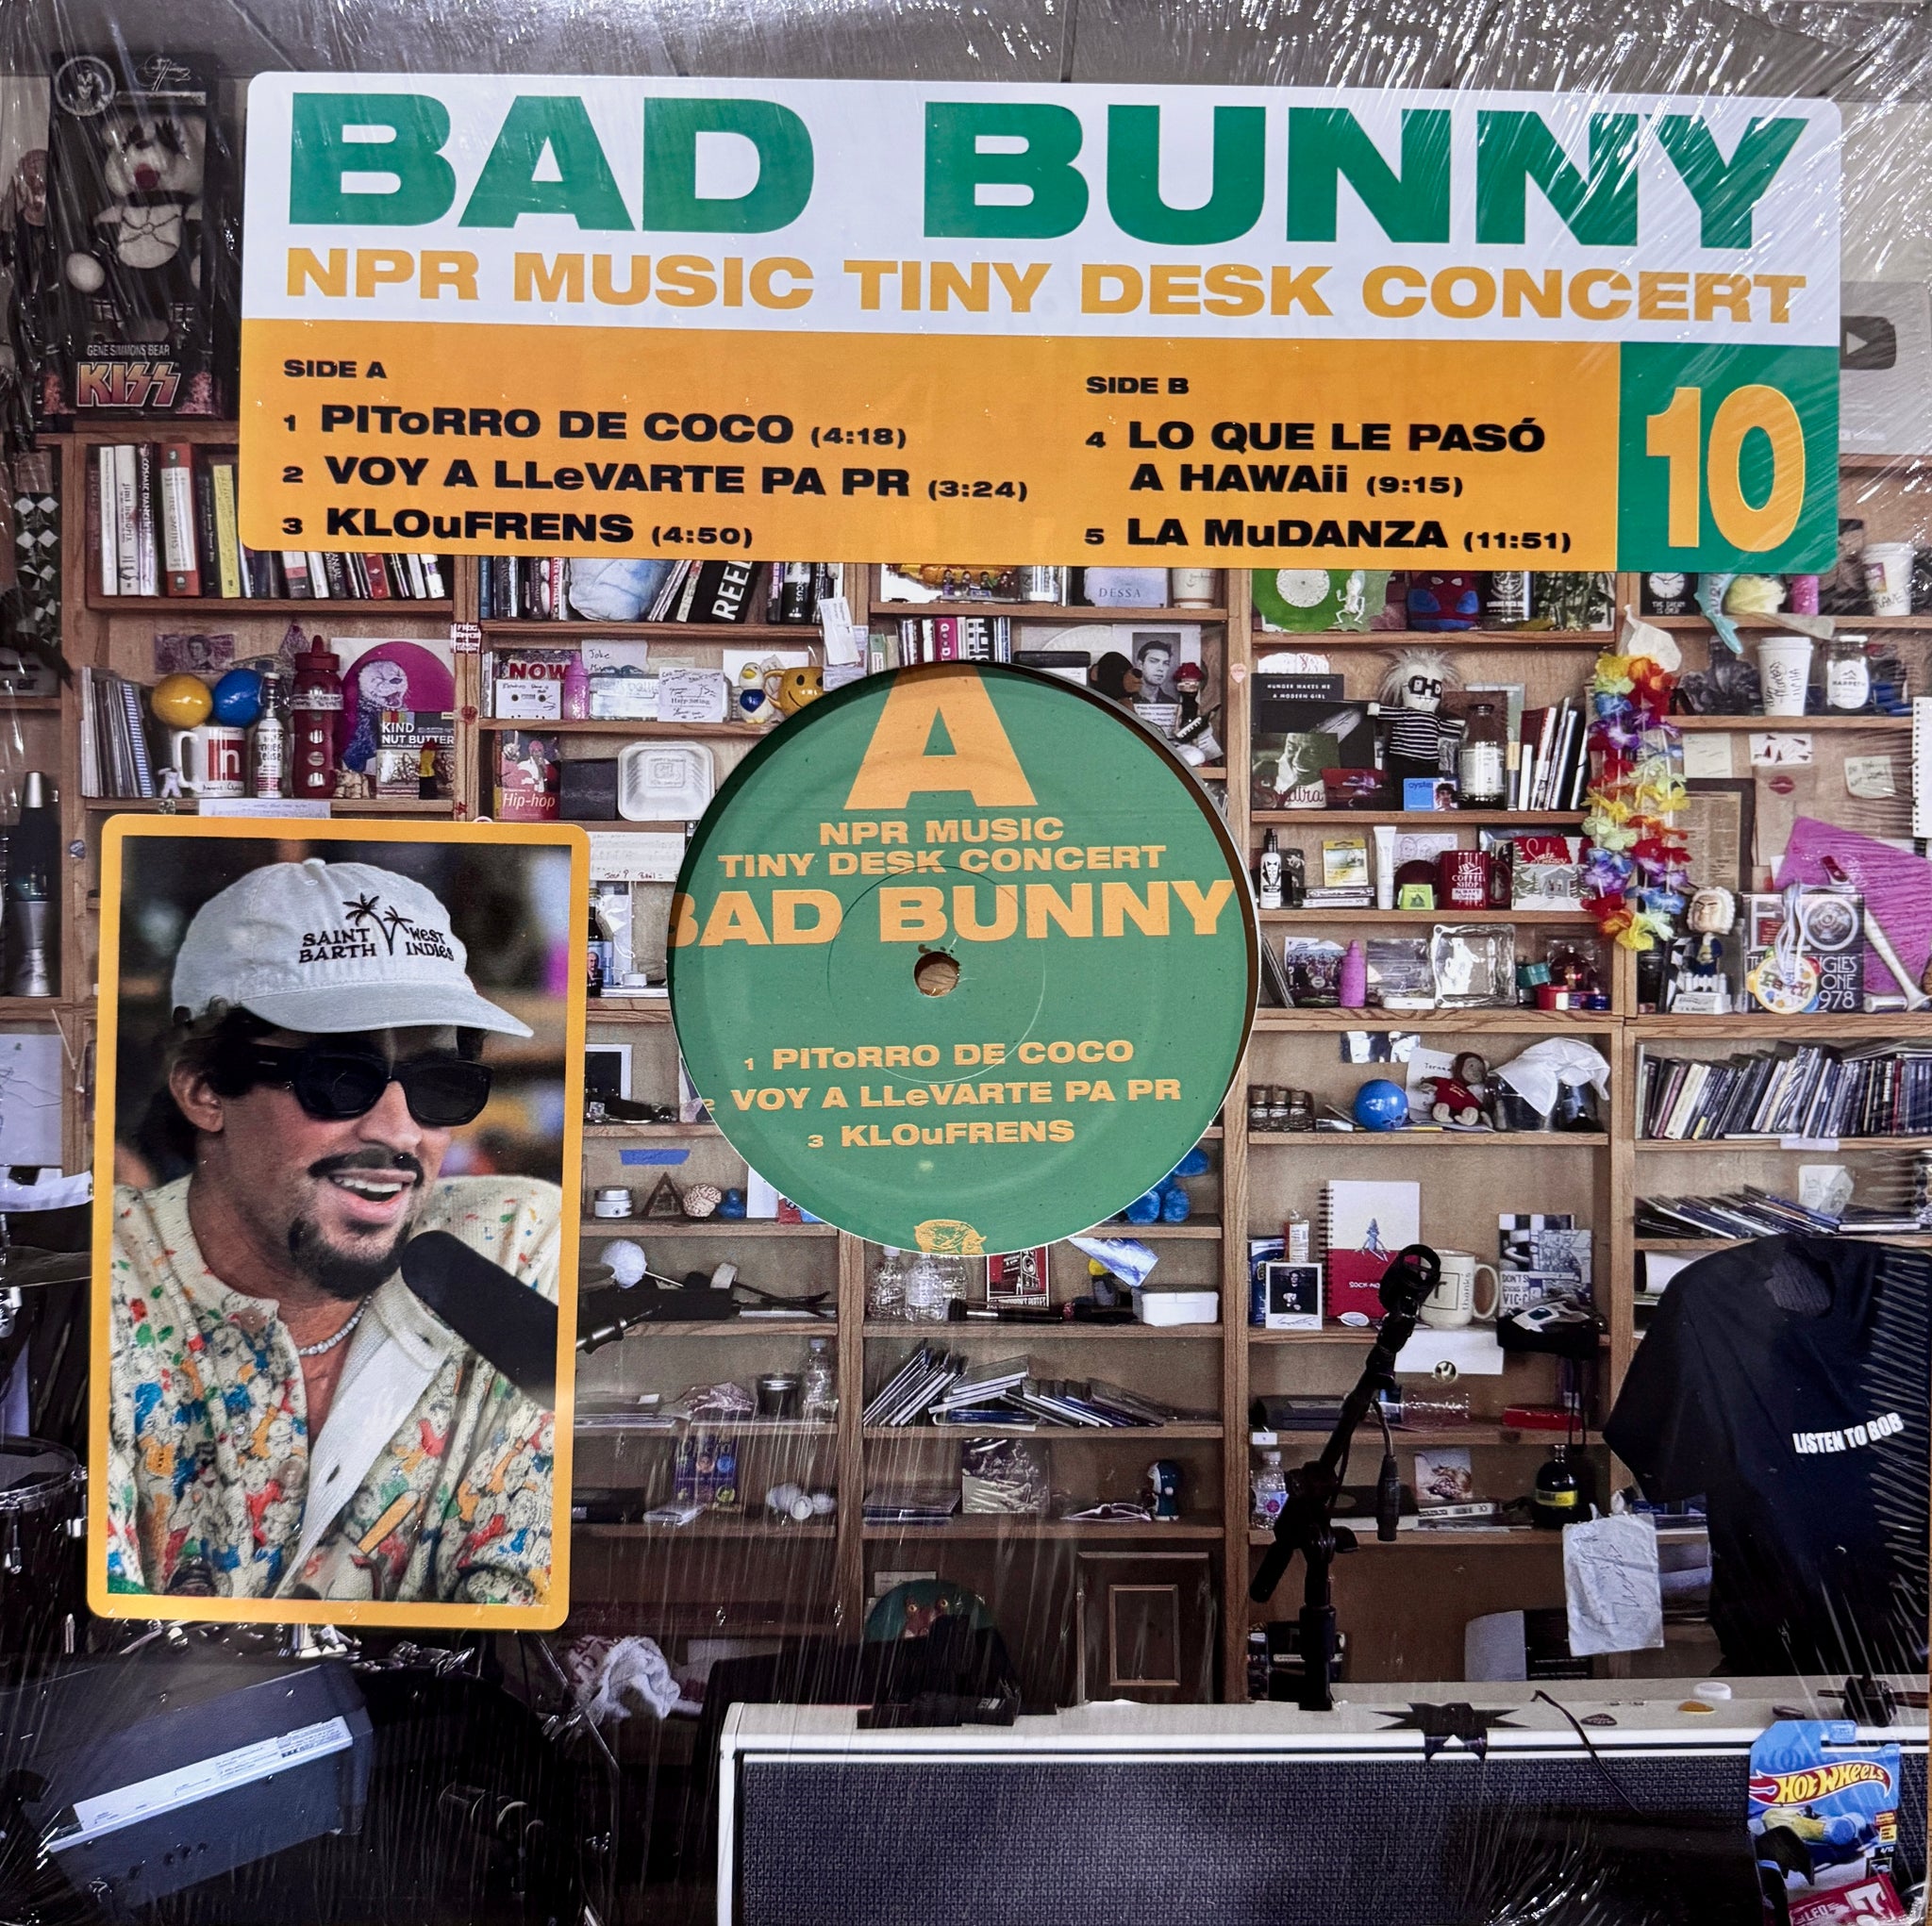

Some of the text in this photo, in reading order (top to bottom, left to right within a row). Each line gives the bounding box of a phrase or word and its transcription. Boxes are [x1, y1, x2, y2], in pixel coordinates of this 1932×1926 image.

[289, 91, 1809, 250] BAD BUNNY
[287, 247, 1807, 324] NPR MUSIC TINY DESK CONCERT
[77, 361, 181, 407] KISS
[284, 359, 388, 379] SIDE A
[1086, 375, 1189, 394] SIDE B
[283, 406, 908, 449] 1 PIToRRO DE COCO (4:18)
[1085, 417, 1545, 454] 4 LO QUE LE PASÓ
[282, 457, 1029, 502] 2 VOY A LLeVARTE PA PR (3:24)
[1130, 465, 1464, 496] A HAWAii (9:15)
[1646, 384, 1807, 554] 10
[281, 509, 754, 547] 3 KLOuFRENS (4:50)
[1084, 520, 1573, 554] 5 LA MuDANZA (11:51)
[1099, 588, 1141, 598] DESSA
[509, 663, 571, 680] NOW
[382, 722, 414, 733] KIND
[382, 736, 454, 744] NUT BUTTER
[845, 660, 1038, 809] A
[503, 792, 555, 810] Hip-hop
[819, 818, 1064, 846] NPR MUSIC
[718, 845, 1167, 878] TINY DESK CONCERT
[667, 880, 1235, 947] BAD BUNNY
[299, 943, 377, 963] BARTH
[302, 928, 371, 947] SAINT
[744, 1040, 1134, 1071] 1 PIToRRO DE COCO
[732, 1088, 811, 1111] VOY
[822, 1088, 849, 1108] A
[860, 1082, 1053, 1107] LLeVARTE
[1066, 1081, 1116, 1103] PA
[1129, 1080, 1181, 1102] PR
[808, 1121, 1075, 1148] 3 KLOuFRENS
[1792, 1412, 1904, 1453] LISTEN TO BOB
[1773, 1773, 1819, 1802] HOT
